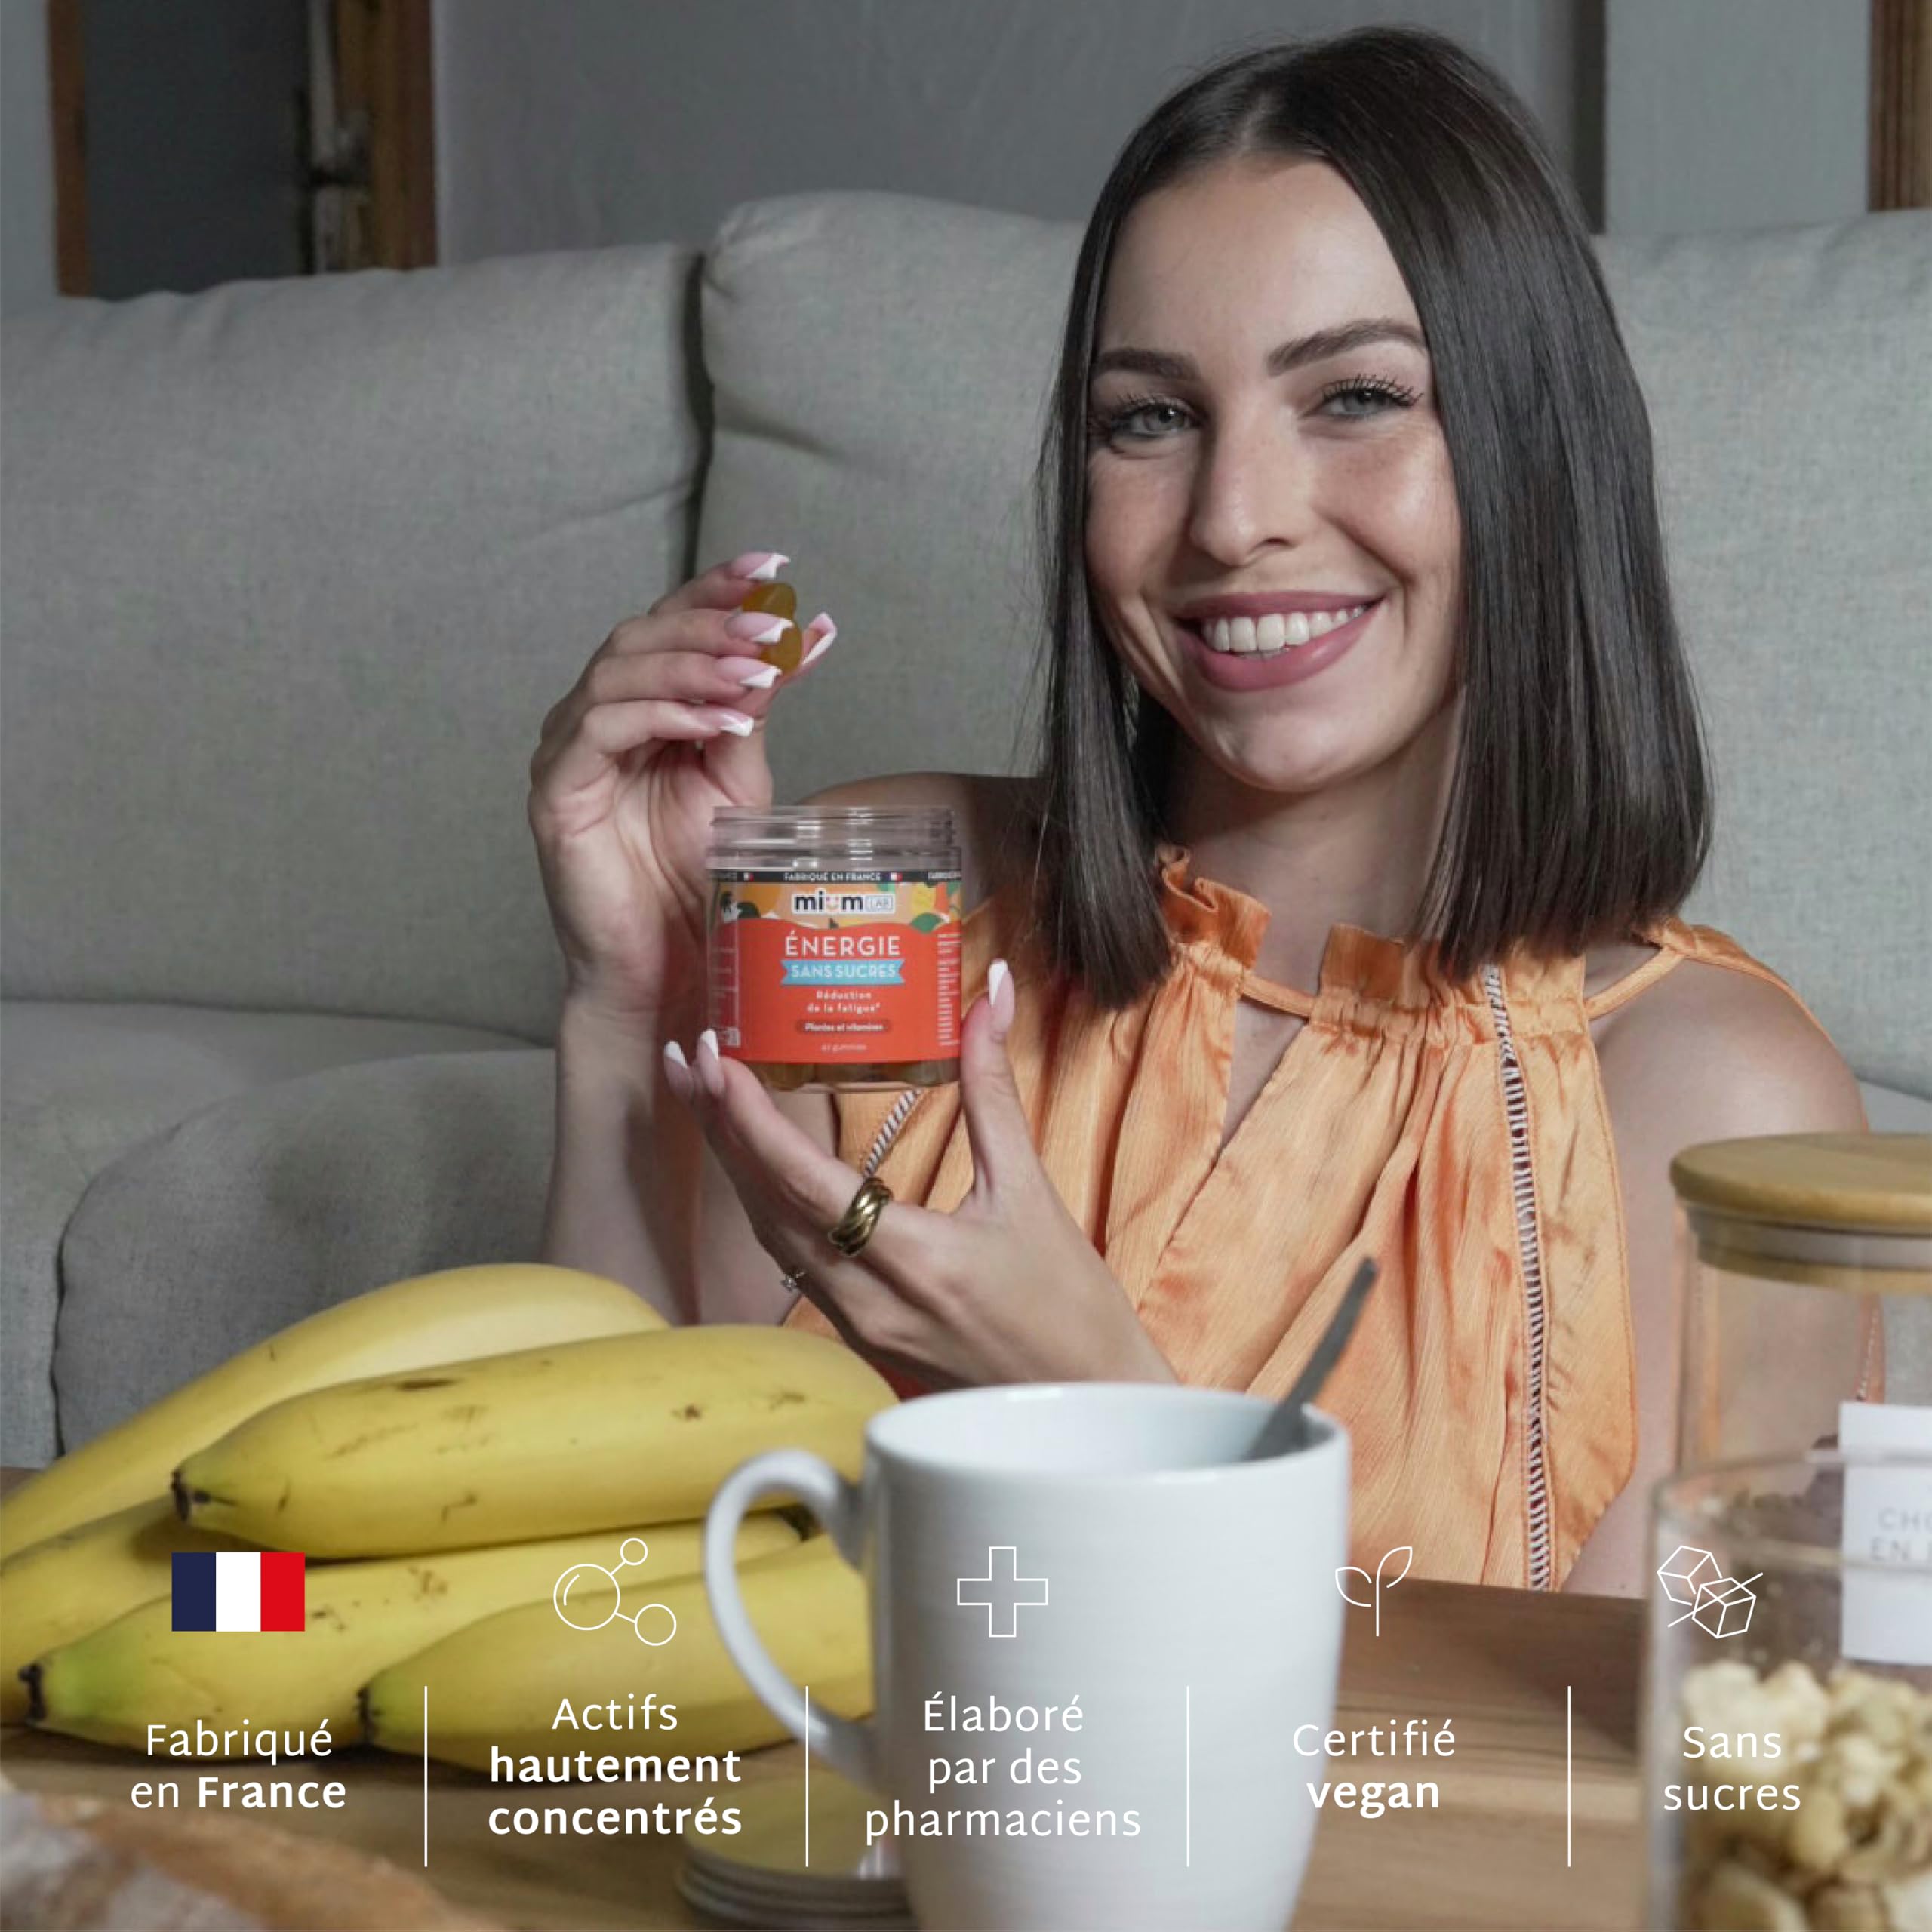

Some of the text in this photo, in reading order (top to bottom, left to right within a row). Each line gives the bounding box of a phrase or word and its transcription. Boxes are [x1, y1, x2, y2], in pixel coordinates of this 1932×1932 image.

[845, 872, 880, 881] FRANCE
[785, 930, 901, 956] ÉNERGIE
[790, 964, 897, 979] SANS SUCRES
[816, 989, 872, 1000] Réduction
[807, 1002, 820, 1013] de
[823, 1002, 834, 1013] la
